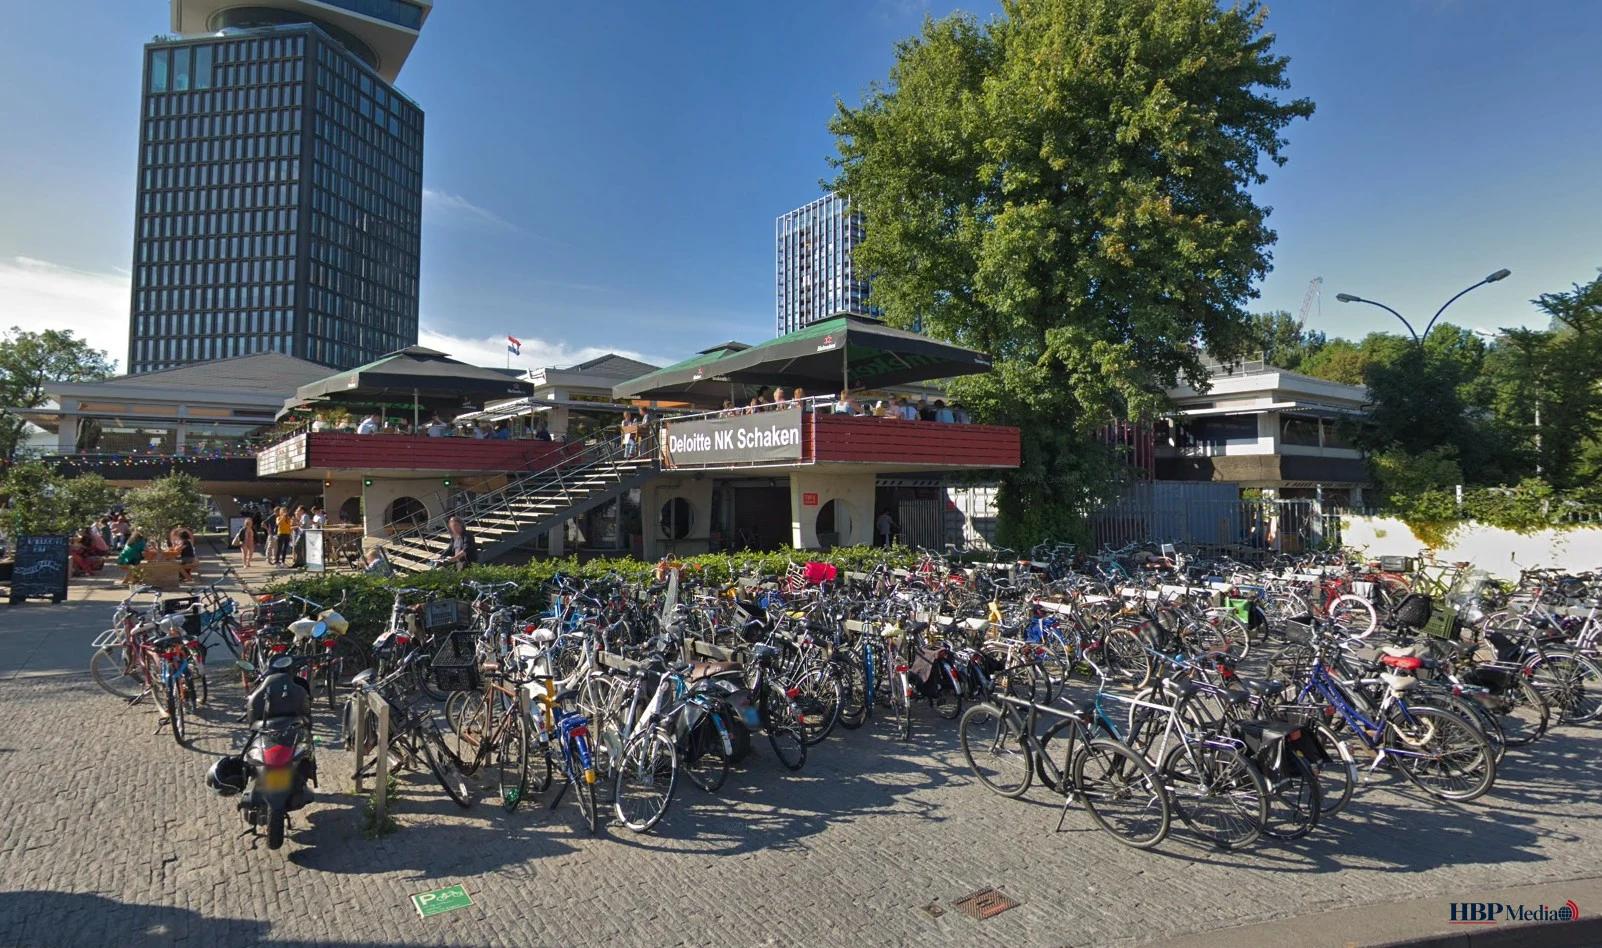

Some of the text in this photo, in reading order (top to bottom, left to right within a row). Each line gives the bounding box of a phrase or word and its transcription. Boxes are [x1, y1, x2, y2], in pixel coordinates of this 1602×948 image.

[669, 425, 799, 453] Deloitte NK Schaken
[418, 893, 437, 906] P
